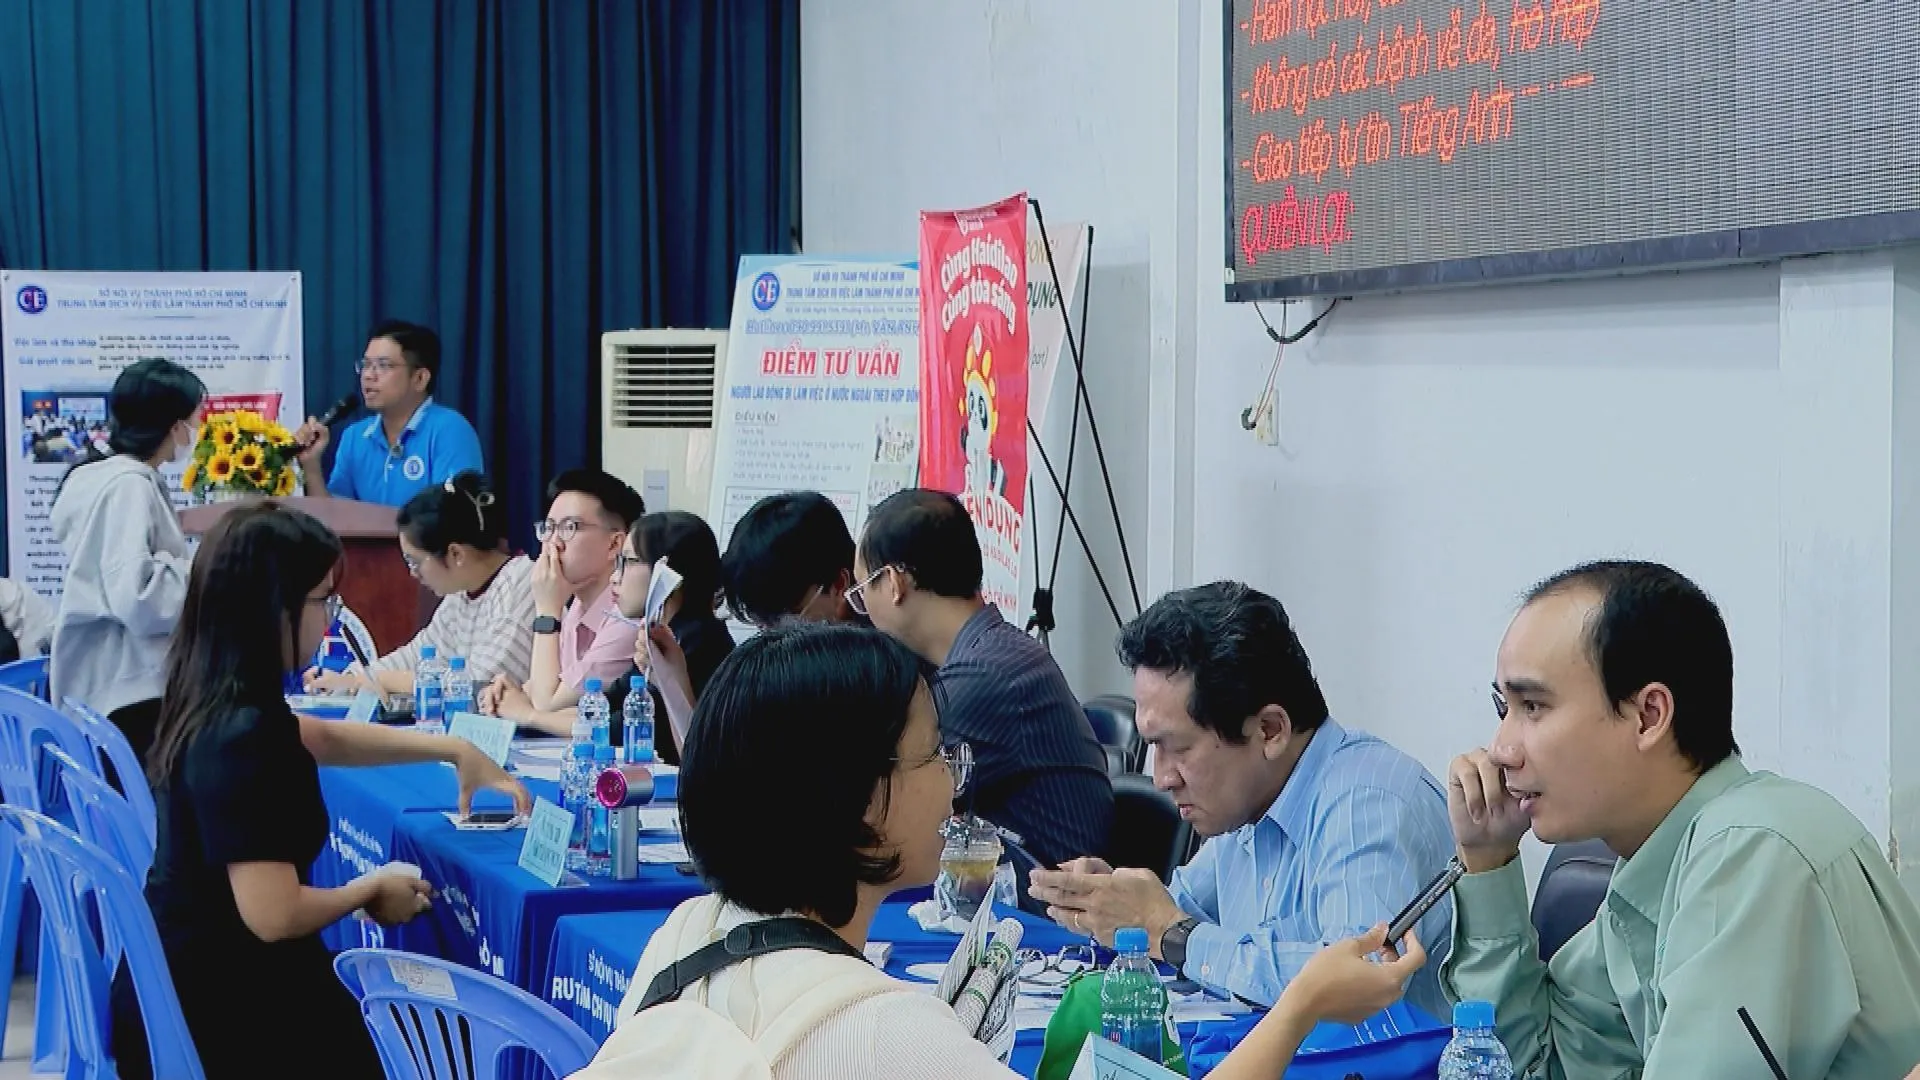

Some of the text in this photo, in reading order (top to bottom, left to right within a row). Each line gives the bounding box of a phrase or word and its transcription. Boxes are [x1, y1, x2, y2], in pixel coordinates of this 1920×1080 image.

[1312, 41, 1337, 99] có
[1339, 33, 1371, 94] các
[1375, 16, 1430, 95] bệnh
[1436, 8, 1462, 72] về
[1298, 117, 1334, 184] tiếp
[1399, 96, 1460, 164] Tiếng
[1462, 80, 1515, 147] Anh
[763, 339, 900, 376] ĐIỂM TƯ VẤN
